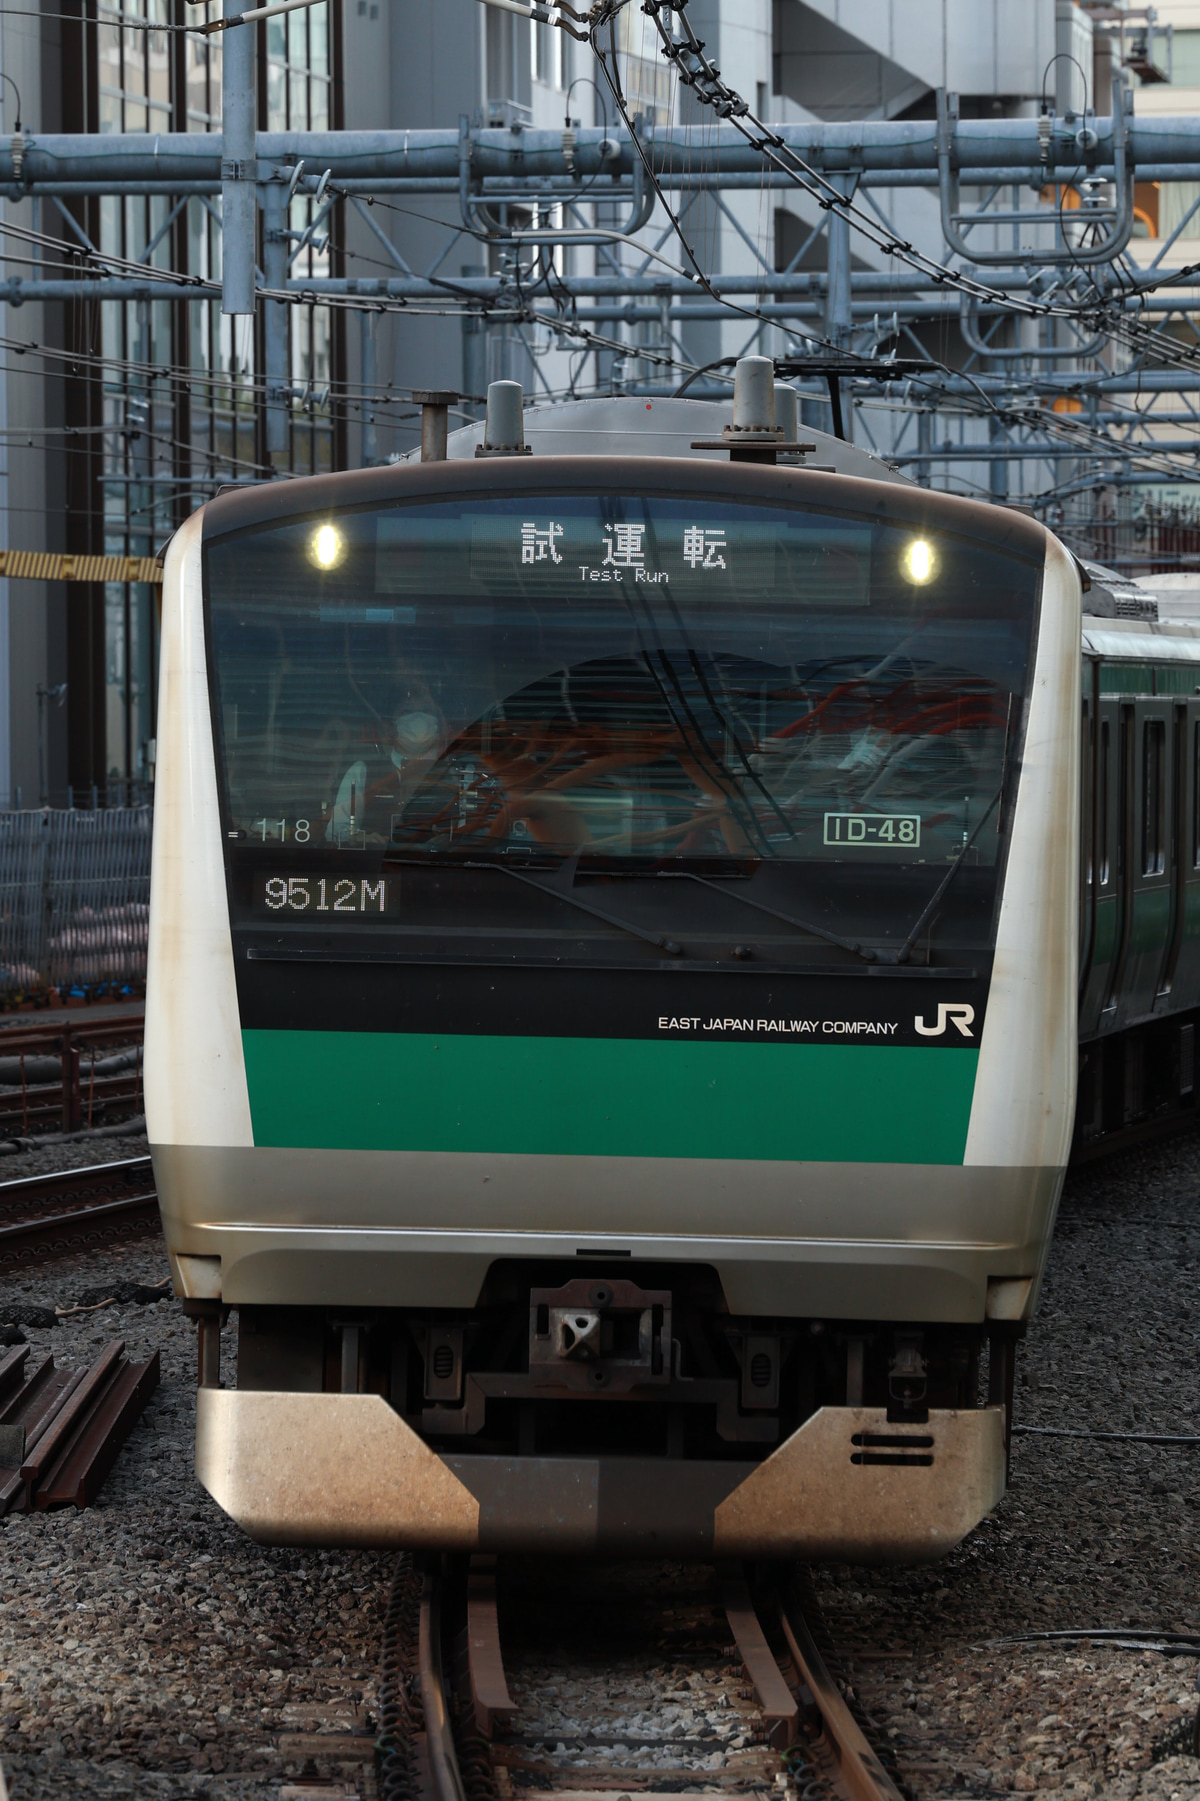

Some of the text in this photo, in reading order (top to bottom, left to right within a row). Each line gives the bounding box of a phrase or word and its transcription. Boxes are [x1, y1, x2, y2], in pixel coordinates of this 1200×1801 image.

[520, 521, 727, 569] 試運転
[578, 566, 669, 583] Test Run
[256, 817, 311, 843] 118
[835, 817, 915, 842] ID-48
[264, 877, 386, 912] 9512M
[658, 1015, 899, 1035] EAST JAPAN RAILWAY COMPANY
[914, 1002, 975, 1037] JR
